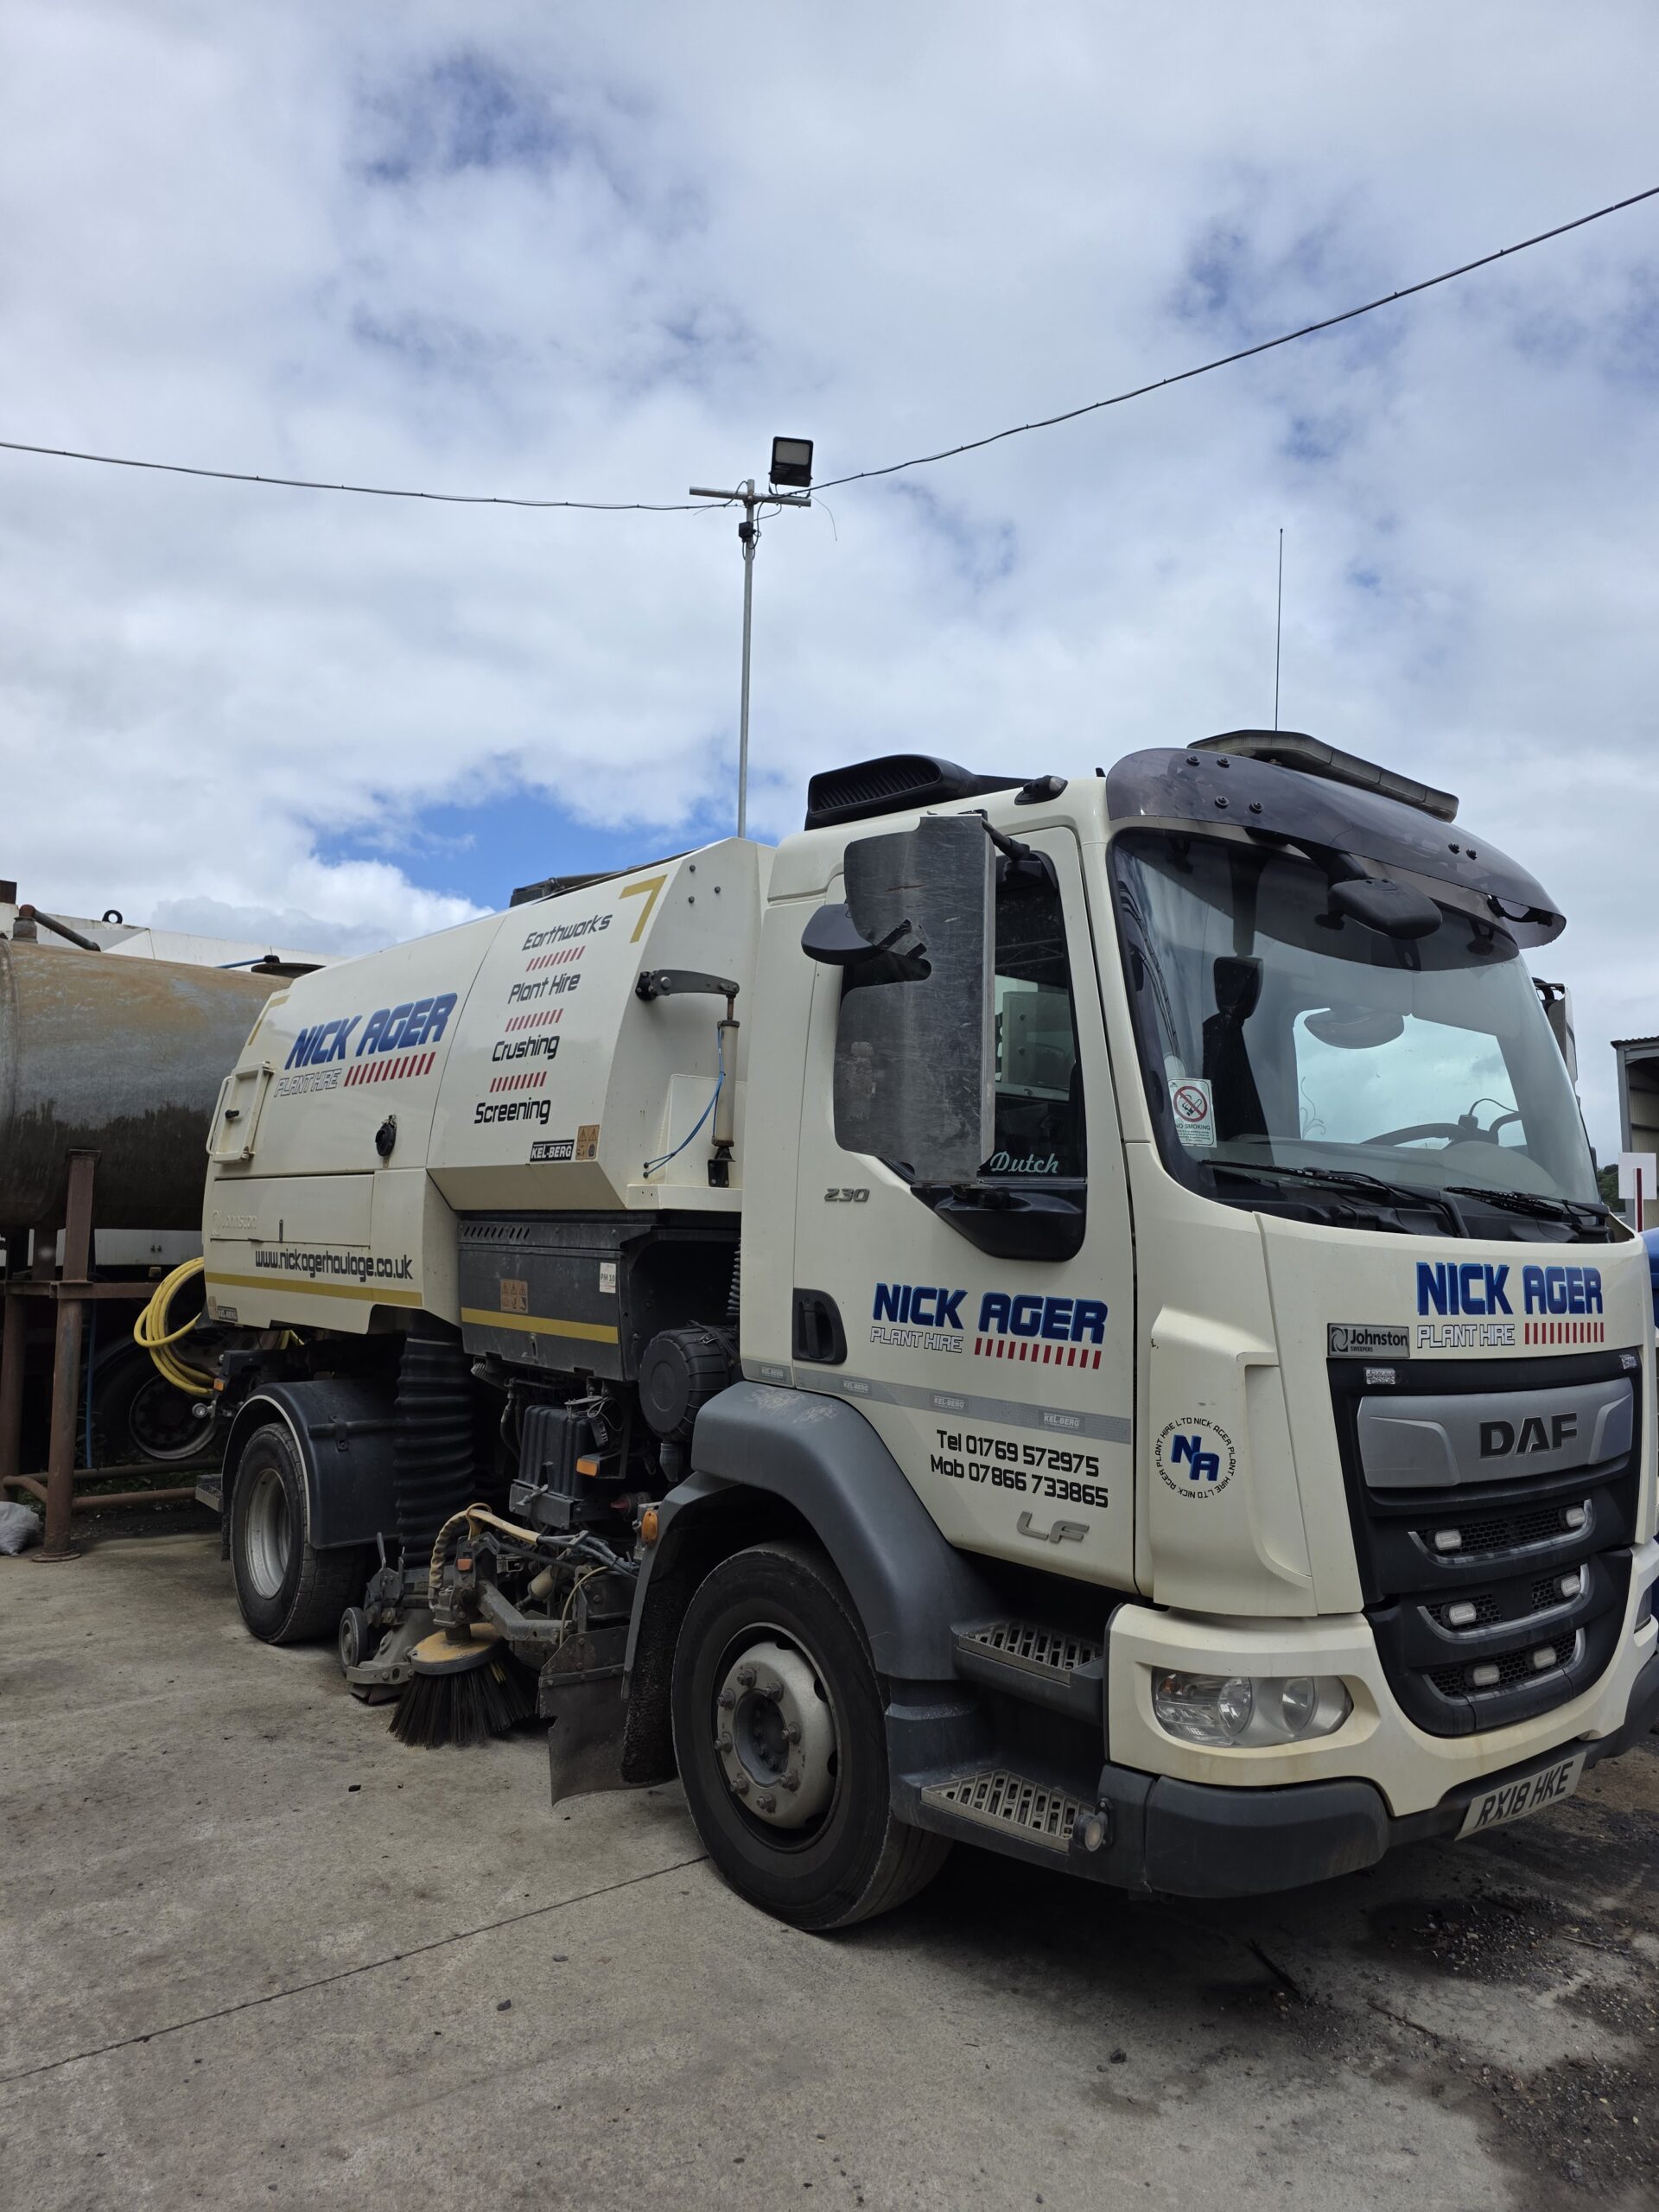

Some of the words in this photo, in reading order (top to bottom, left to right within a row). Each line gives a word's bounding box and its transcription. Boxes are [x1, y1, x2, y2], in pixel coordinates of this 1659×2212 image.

[522, 914, 613, 951] Earthworks
[508, 976, 549, 1004] Plant
[548, 973, 581, 995] Hire
[284, 1014, 363, 1070] NICK
[355, 992, 458, 1057] AGER
[492, 1034, 560, 1062] Crushing
[274, 1072, 315, 1097] PLANT
[310, 1068, 342, 1092] HIRE
[474, 1097, 551, 1125] Screening
[531, 1142, 573, 1159] KEL-BERG
[990, 1151, 1059, 1174] Dutch
[823, 1188, 870, 1203] 230
[255, 1249, 413, 1282] www.nickagerhaulage.co.uk
[1415, 1262, 1514, 1316] NICK
[1522, 1265, 1604, 1315] AGER
[873, 1283, 969, 1330] NICK
[978, 1292, 1109, 1344] AGER
[870, 1326, 924, 1348] PLANT
[924, 1332, 963, 1353] HIRE
[1351, 1329, 1408, 1346] Johnston
[1417, 1324, 1477, 1348] PLANT
[1479, 1324, 1515, 1346] HIRE
[843, 1382, 869, 1392] KEL-BERG
[933, 1396, 963, 1409] KEL-BERG
[1044, 1414, 1079, 1427] KEL-BERG
[1160, 1422, 1175, 1439] HIRE
[1175, 1417, 1192, 1427] LTD
[1193, 1417, 1212, 1428] NICK
[1478, 1412, 1578, 1459] DAF
[937, 1429, 961, 1452] Tel
[966, 1435, 1018, 1462] 01769
[1023, 1445, 1099, 1478] 572975
[1154, 1438, 1163, 1468] PLANT
[931, 1454, 964, 1478] Mob
[969, 1462, 1027, 1491] 07866
[1031, 1474, 1109, 1508] 733865
[1177, 1487, 1196, 1498] NICK
[1197, 1489, 1215, 1498] LTD
[1214, 1476, 1231, 1493] HIRE
[1016, 1511, 1090, 1543] LF
[1474, 1781, 1531, 1829] RX18
[1529, 1761, 1574, 1808] HKE
